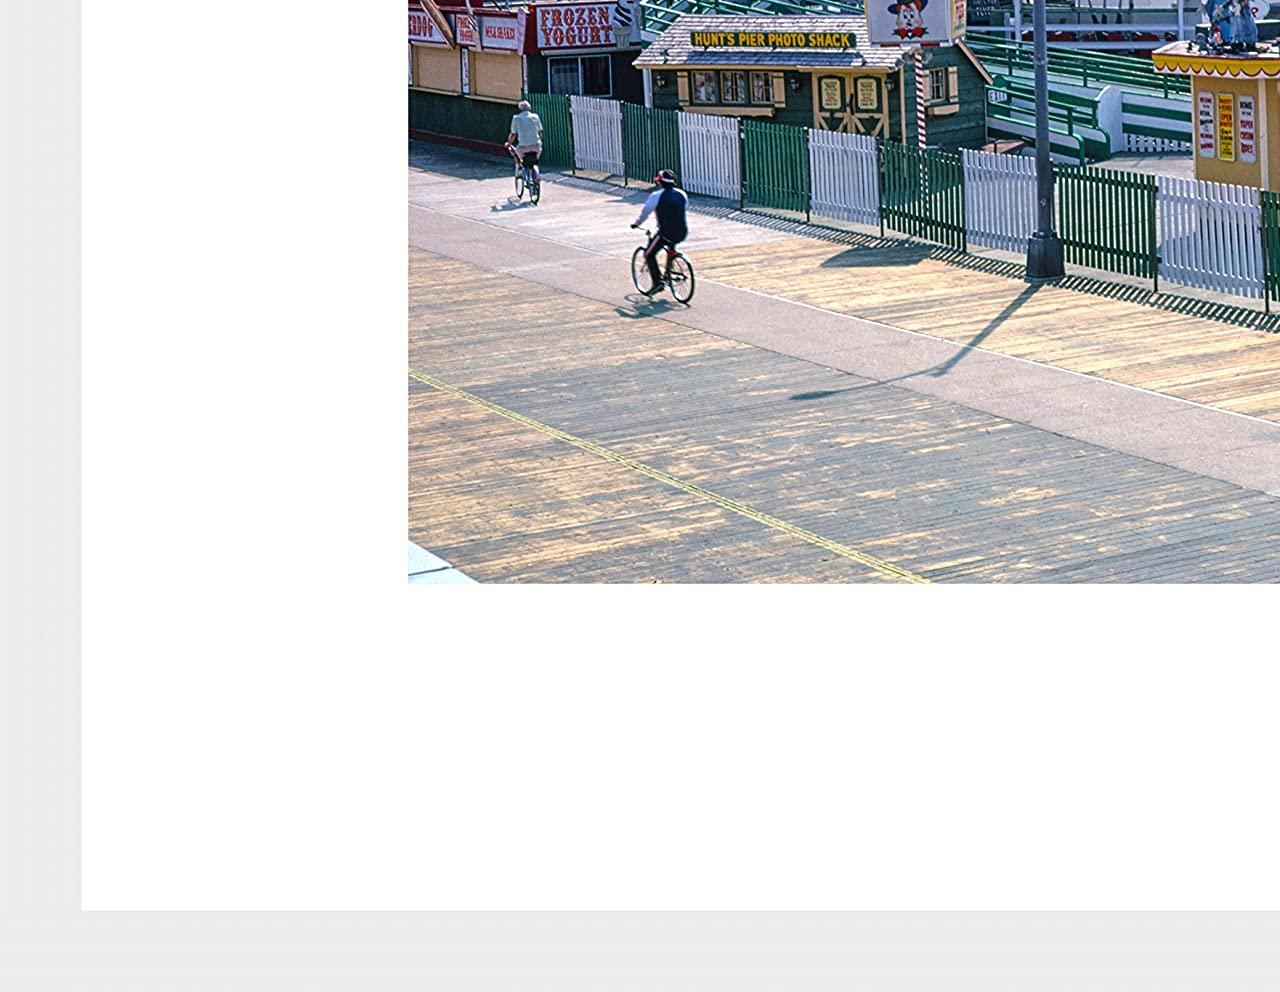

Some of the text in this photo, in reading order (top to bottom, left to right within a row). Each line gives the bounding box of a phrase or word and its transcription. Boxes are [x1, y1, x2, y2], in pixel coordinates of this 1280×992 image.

[541, 7, 610, 27] FROZEN
[541, 25, 613, 46] YOGURT
[695, 32, 850, 47] HUNT'S PIER PHOTO SHACK
